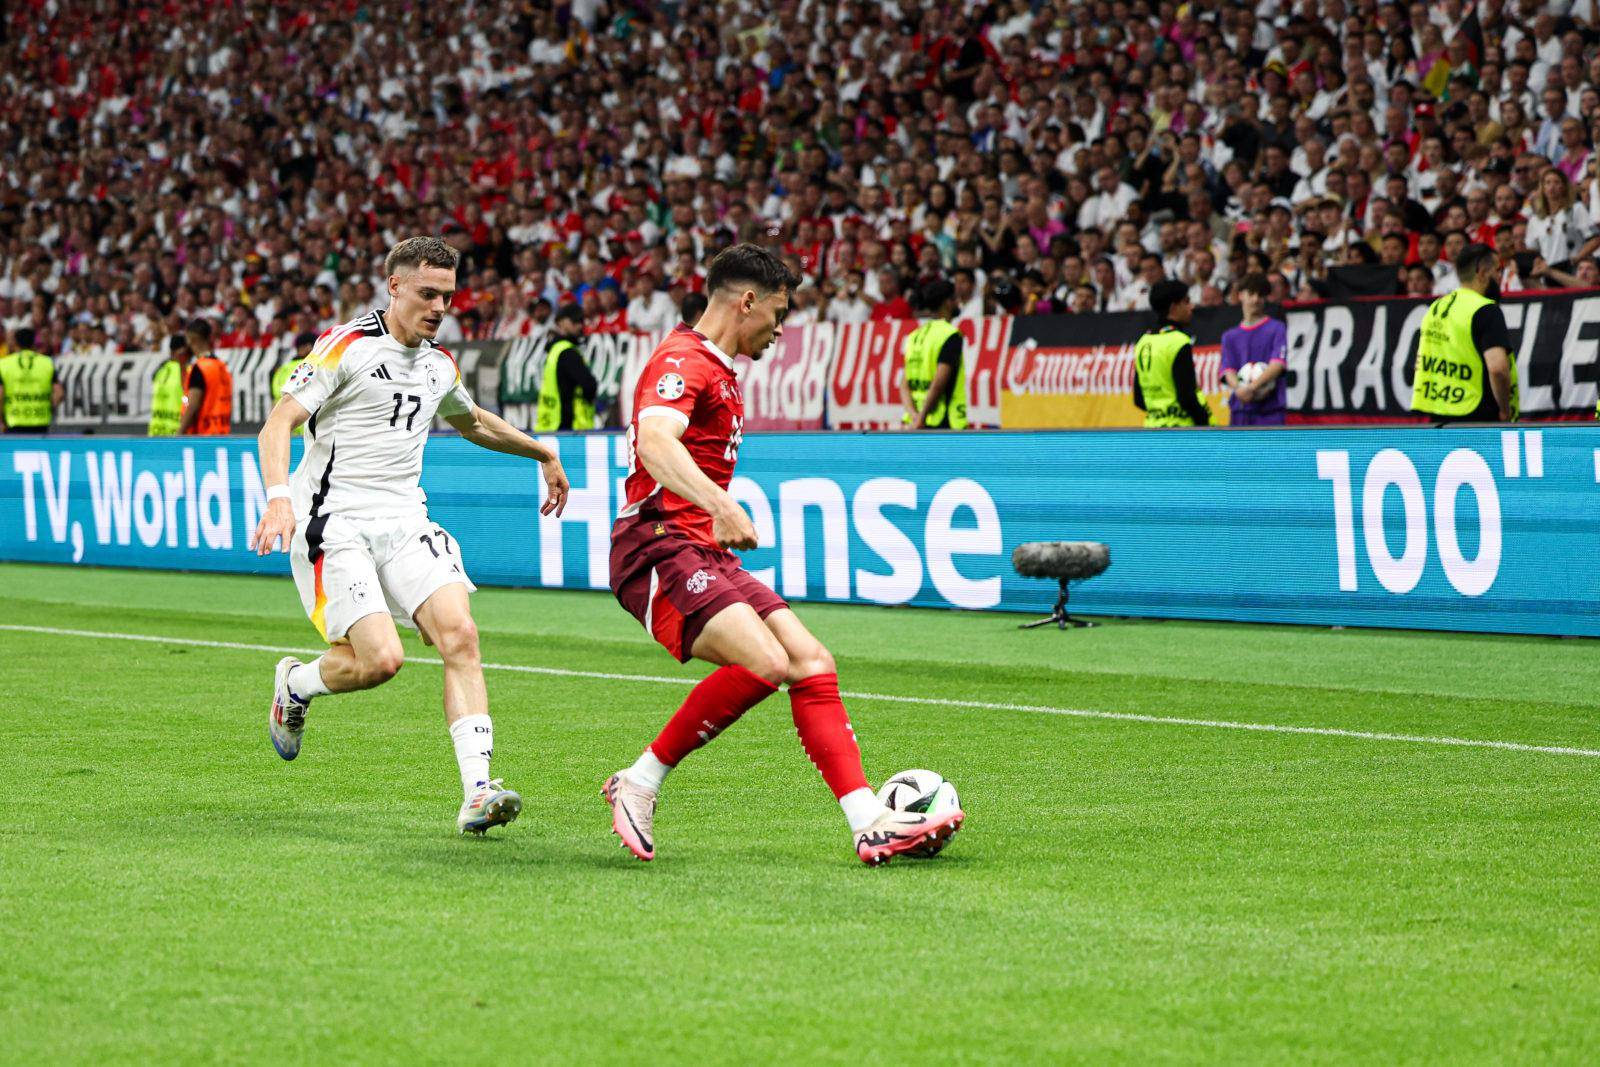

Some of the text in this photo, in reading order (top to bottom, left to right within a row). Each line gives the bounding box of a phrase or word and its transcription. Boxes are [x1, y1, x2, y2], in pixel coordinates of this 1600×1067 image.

[389, 392, 422, 431] 17
[13, 450, 84, 563] TV,
[86, 447, 234, 550] World
[419, 529, 453, 559] 17
[538, 435, 1002, 609] Hense
[1316, 430, 1544, 597] 100"
